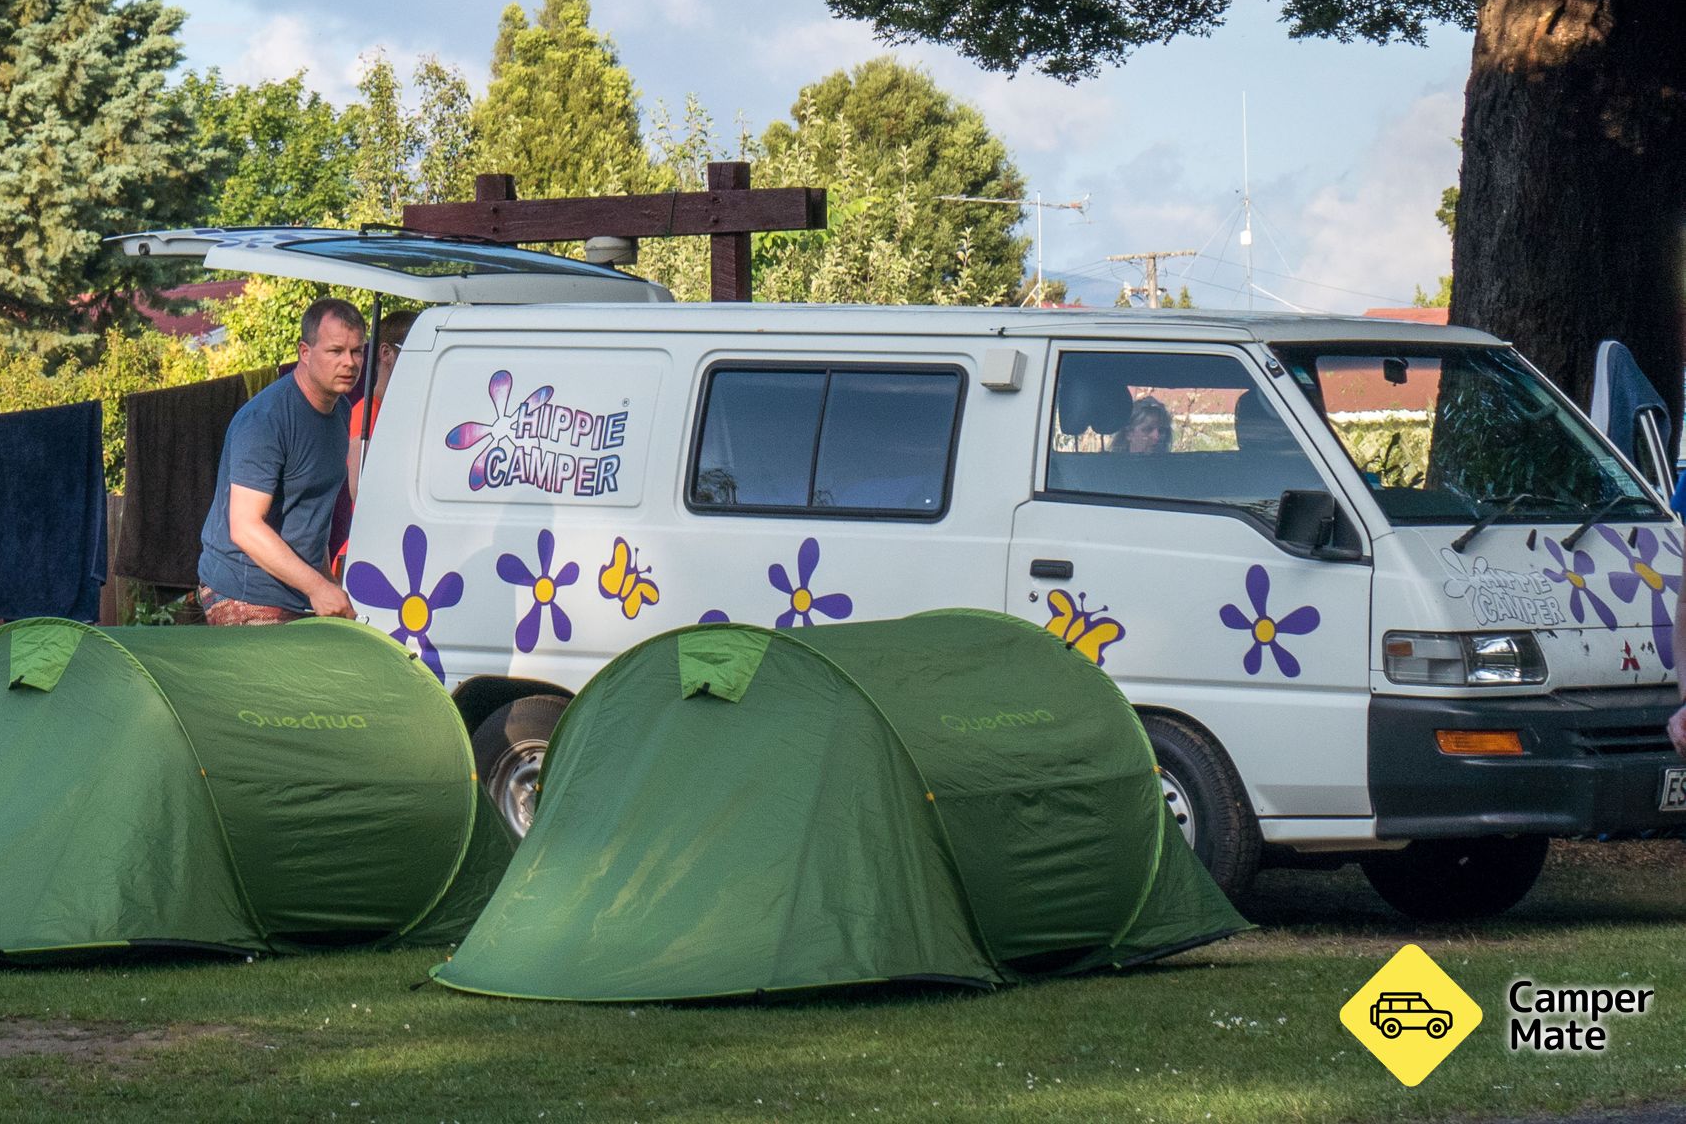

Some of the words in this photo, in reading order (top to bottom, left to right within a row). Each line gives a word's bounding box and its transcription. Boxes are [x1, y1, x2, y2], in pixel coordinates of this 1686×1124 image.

[515, 402, 629, 451] HIPPIE
[485, 446, 621, 497] CAMPER
[1475, 566, 1553, 595] HIPPIE
[1478, 593, 1566, 626] CAMPER
[237, 709, 367, 730] Quechua
[940, 709, 1055, 733] Quechua
